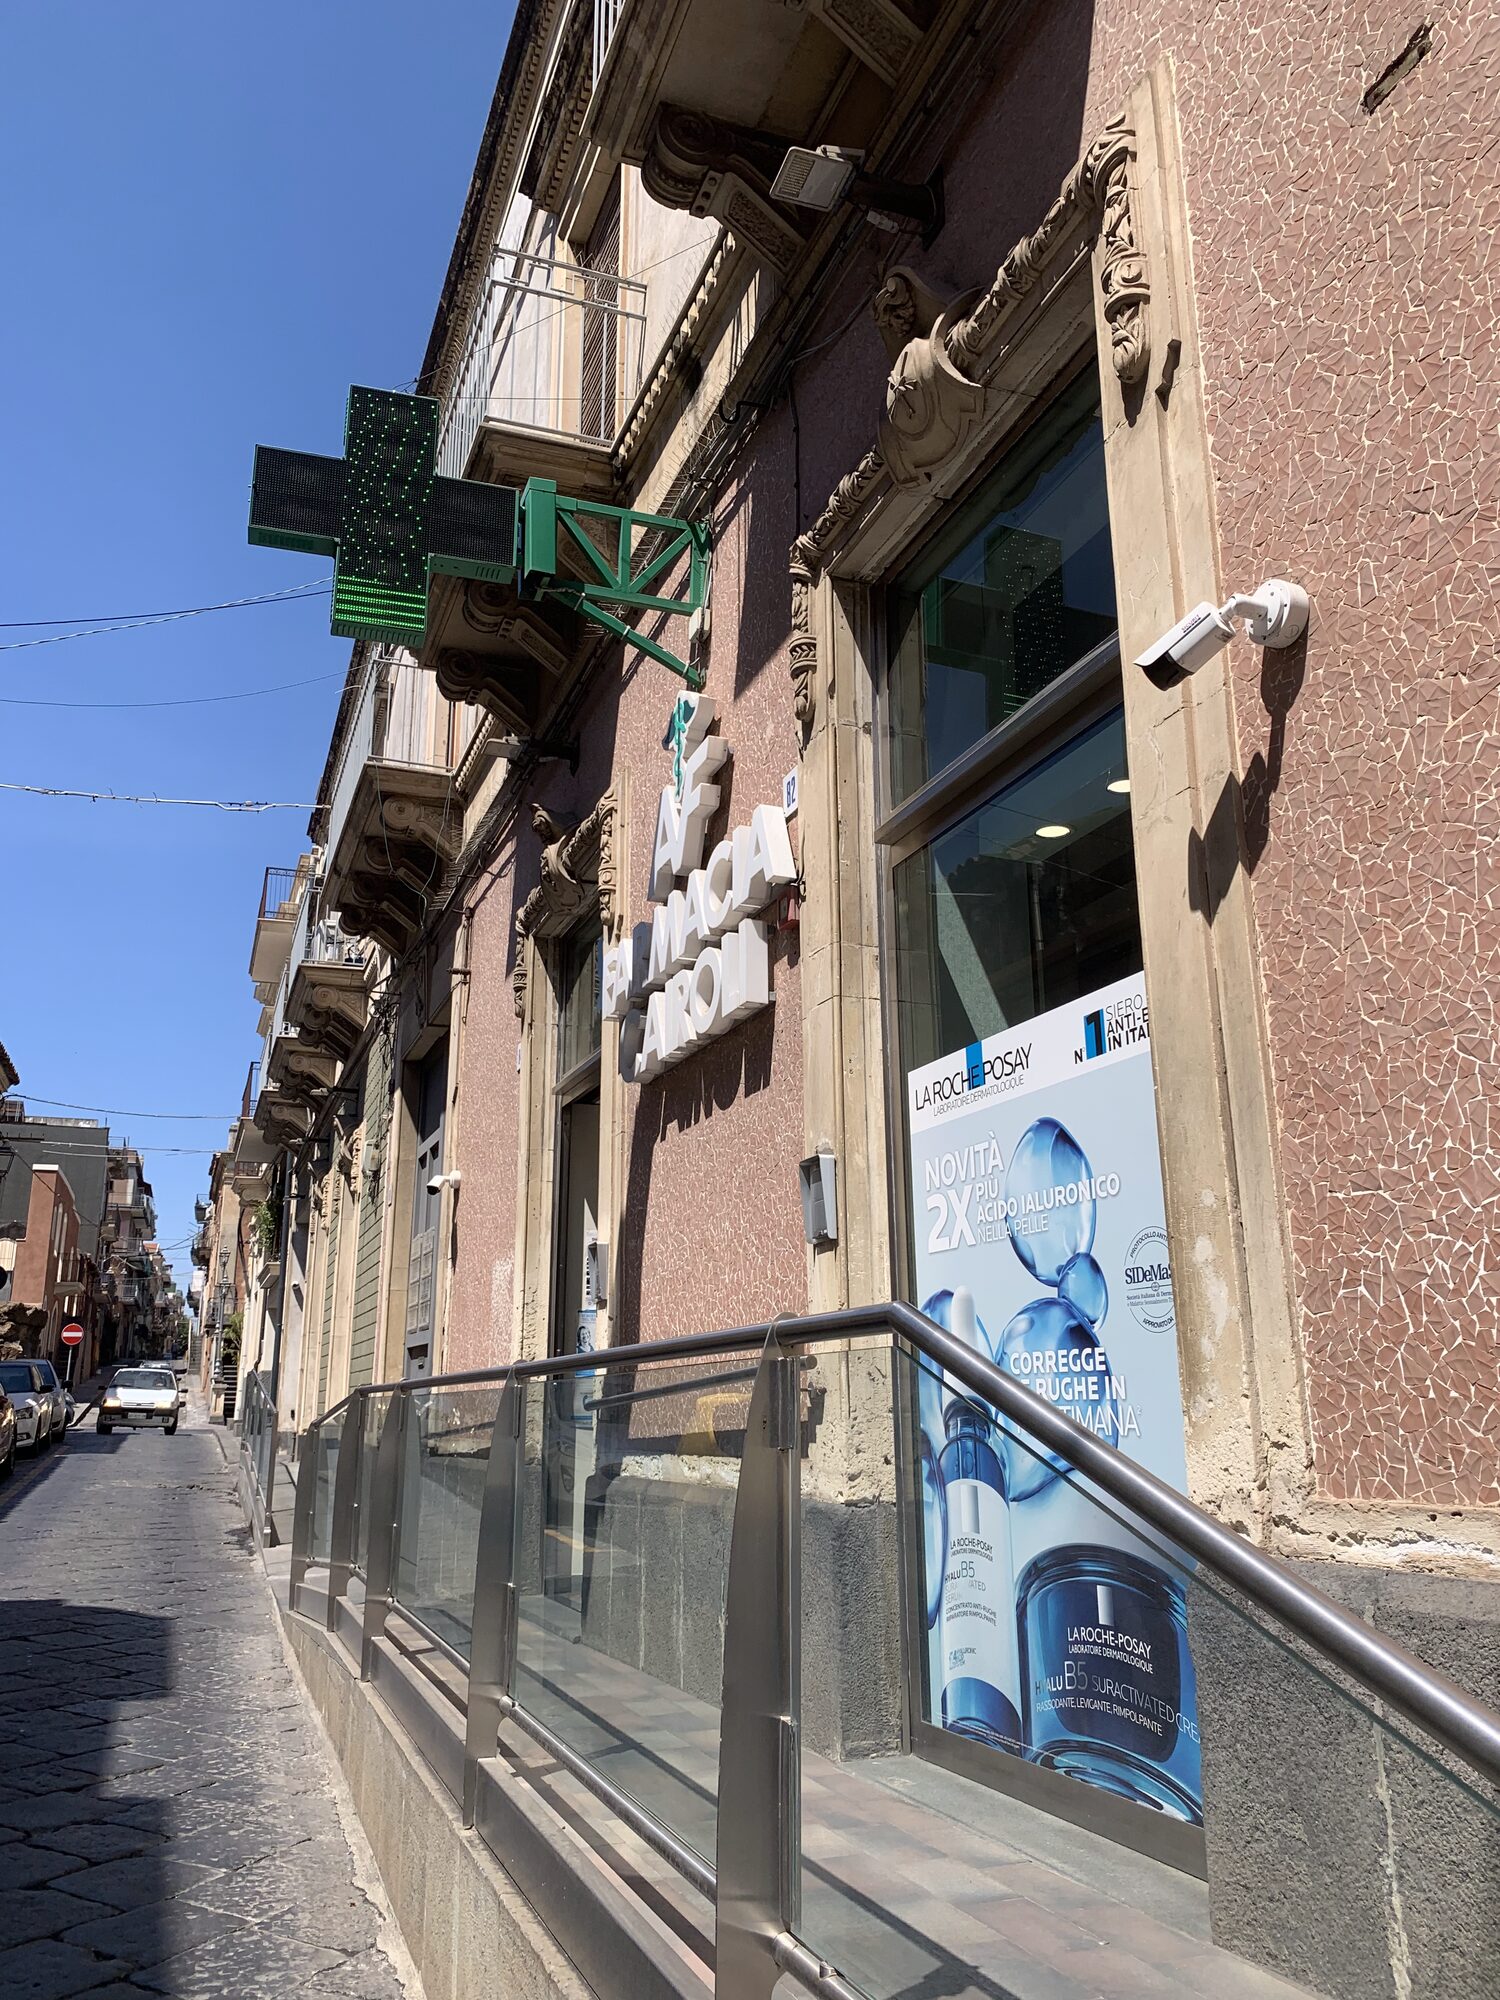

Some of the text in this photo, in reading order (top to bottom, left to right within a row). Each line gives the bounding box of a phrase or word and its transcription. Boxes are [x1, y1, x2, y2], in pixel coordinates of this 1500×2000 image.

[786, 775, 796, 808] 82
[1106, 994, 1143, 1021] SIERO
[1087, 1010, 1103, 1057] 1
[1108, 1033, 1122, 1051] IN
[915, 1043, 1032, 1111] LA ROCHE POSAY
[933, 1074, 1025, 1117] LABORATOIRE DERMATOLOGIQUE
[925, 1131, 1004, 1192] NOVITÀ
[975, 1173, 999, 1200] PIÙ
[976, 1172, 1121, 1226] ACIDO IALURONICO
[926, 1182, 977, 1254] 2X
[977, 1213, 1049, 1245] NELLA PELLE
[1129, 1231, 1157, 1258] PROTOCOLLO
[1010, 1346, 1106, 1375] CORREGGE
[1036, 1375, 1126, 1400] RUGHE IN
[950, 1539, 957, 1550] LA
[944, 1561, 975, 1584] HYALU B5
[1067, 1627, 1151, 1660] LA ROCHE-POSAY
[1068, 1644, 1153, 1674] LABORATOIRE DERMATOLOGIQUE
[1064, 1660, 1088, 1690] B5
[1092, 1674, 1175, 1723] SURACTIVATED
[1175, 1712, 1201, 1745] CRE
[1113, 1705, 1163, 1737] RIMPOLPANTE
